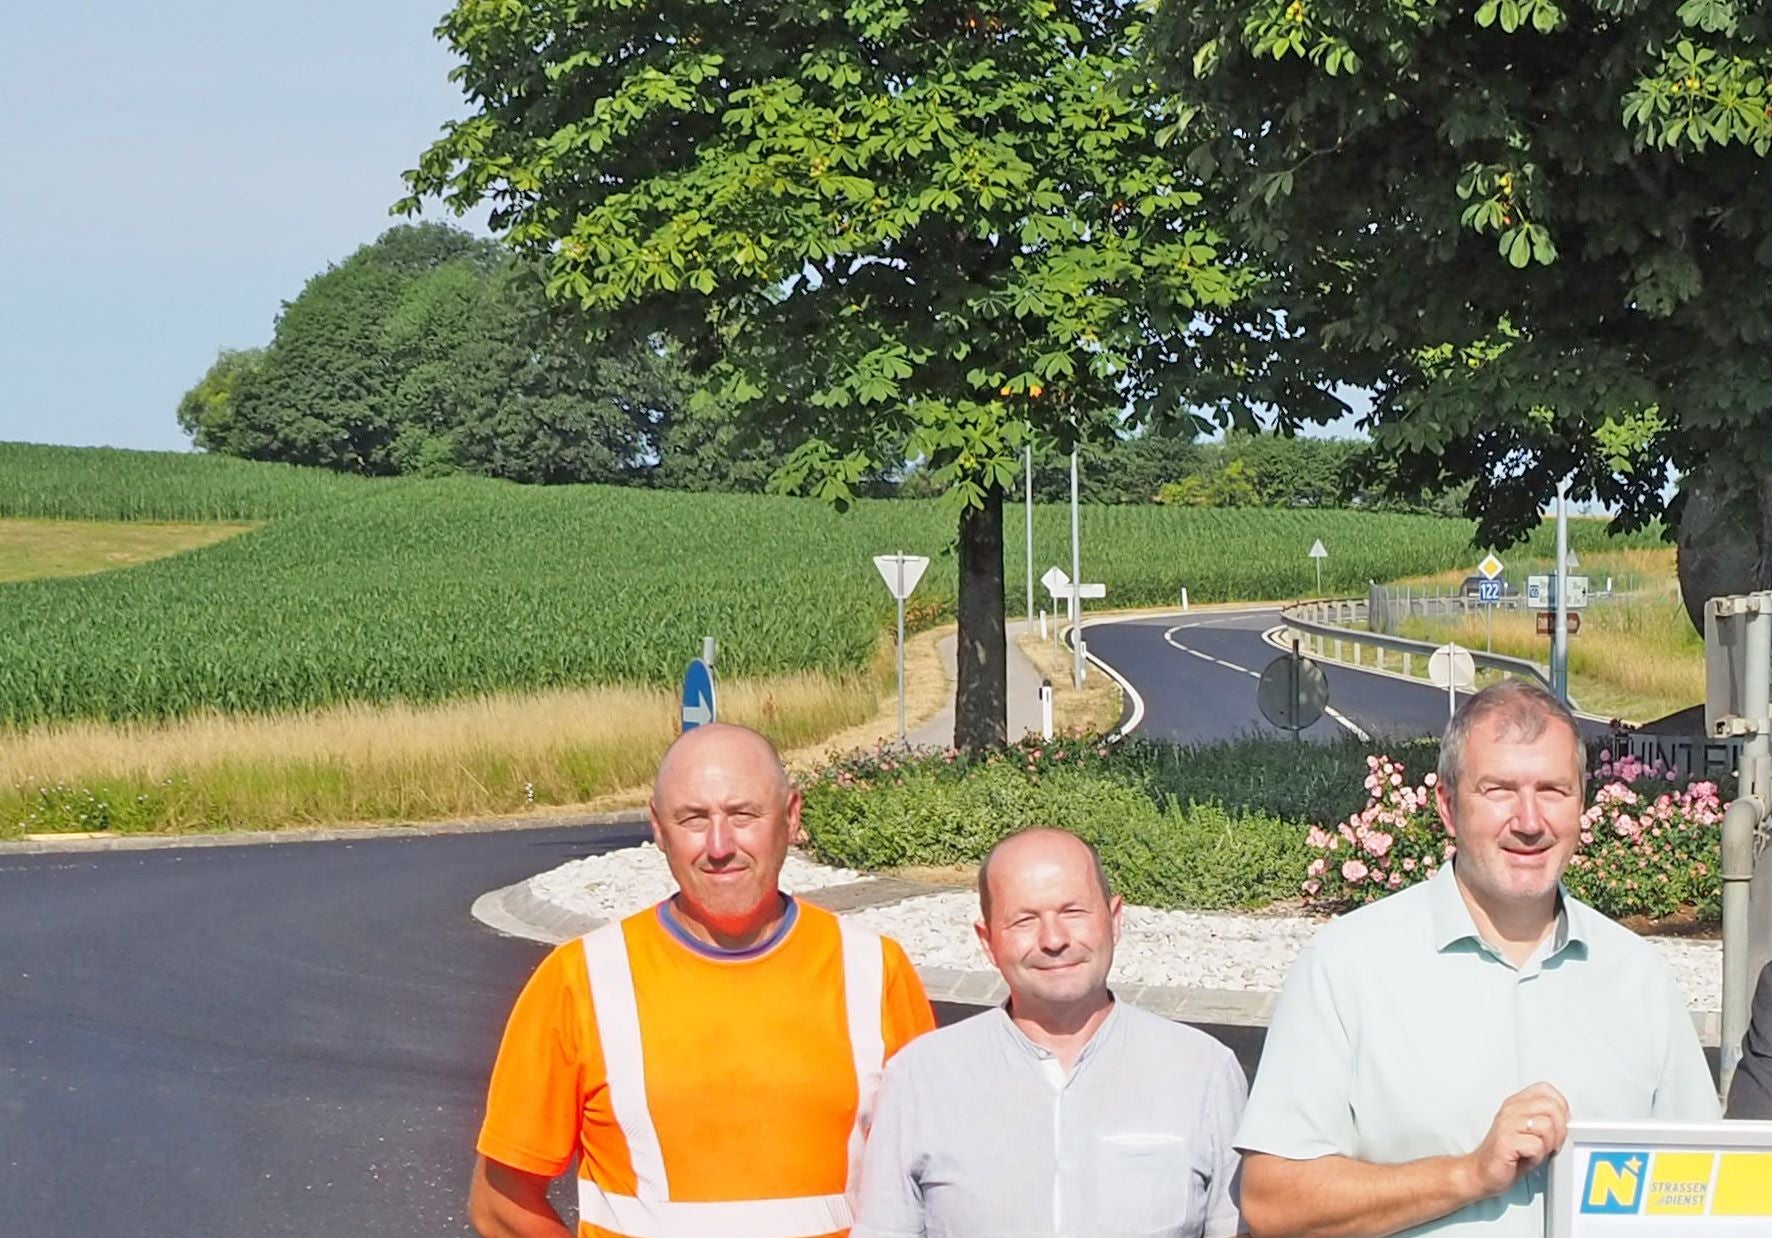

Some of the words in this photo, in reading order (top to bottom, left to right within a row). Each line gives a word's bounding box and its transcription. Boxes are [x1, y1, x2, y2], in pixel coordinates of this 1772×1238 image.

[1481, 583, 1500, 600] 122
[1651, 1182, 1708, 1193] STRASSEN
[1665, 1194, 1704, 1206] DIENST
